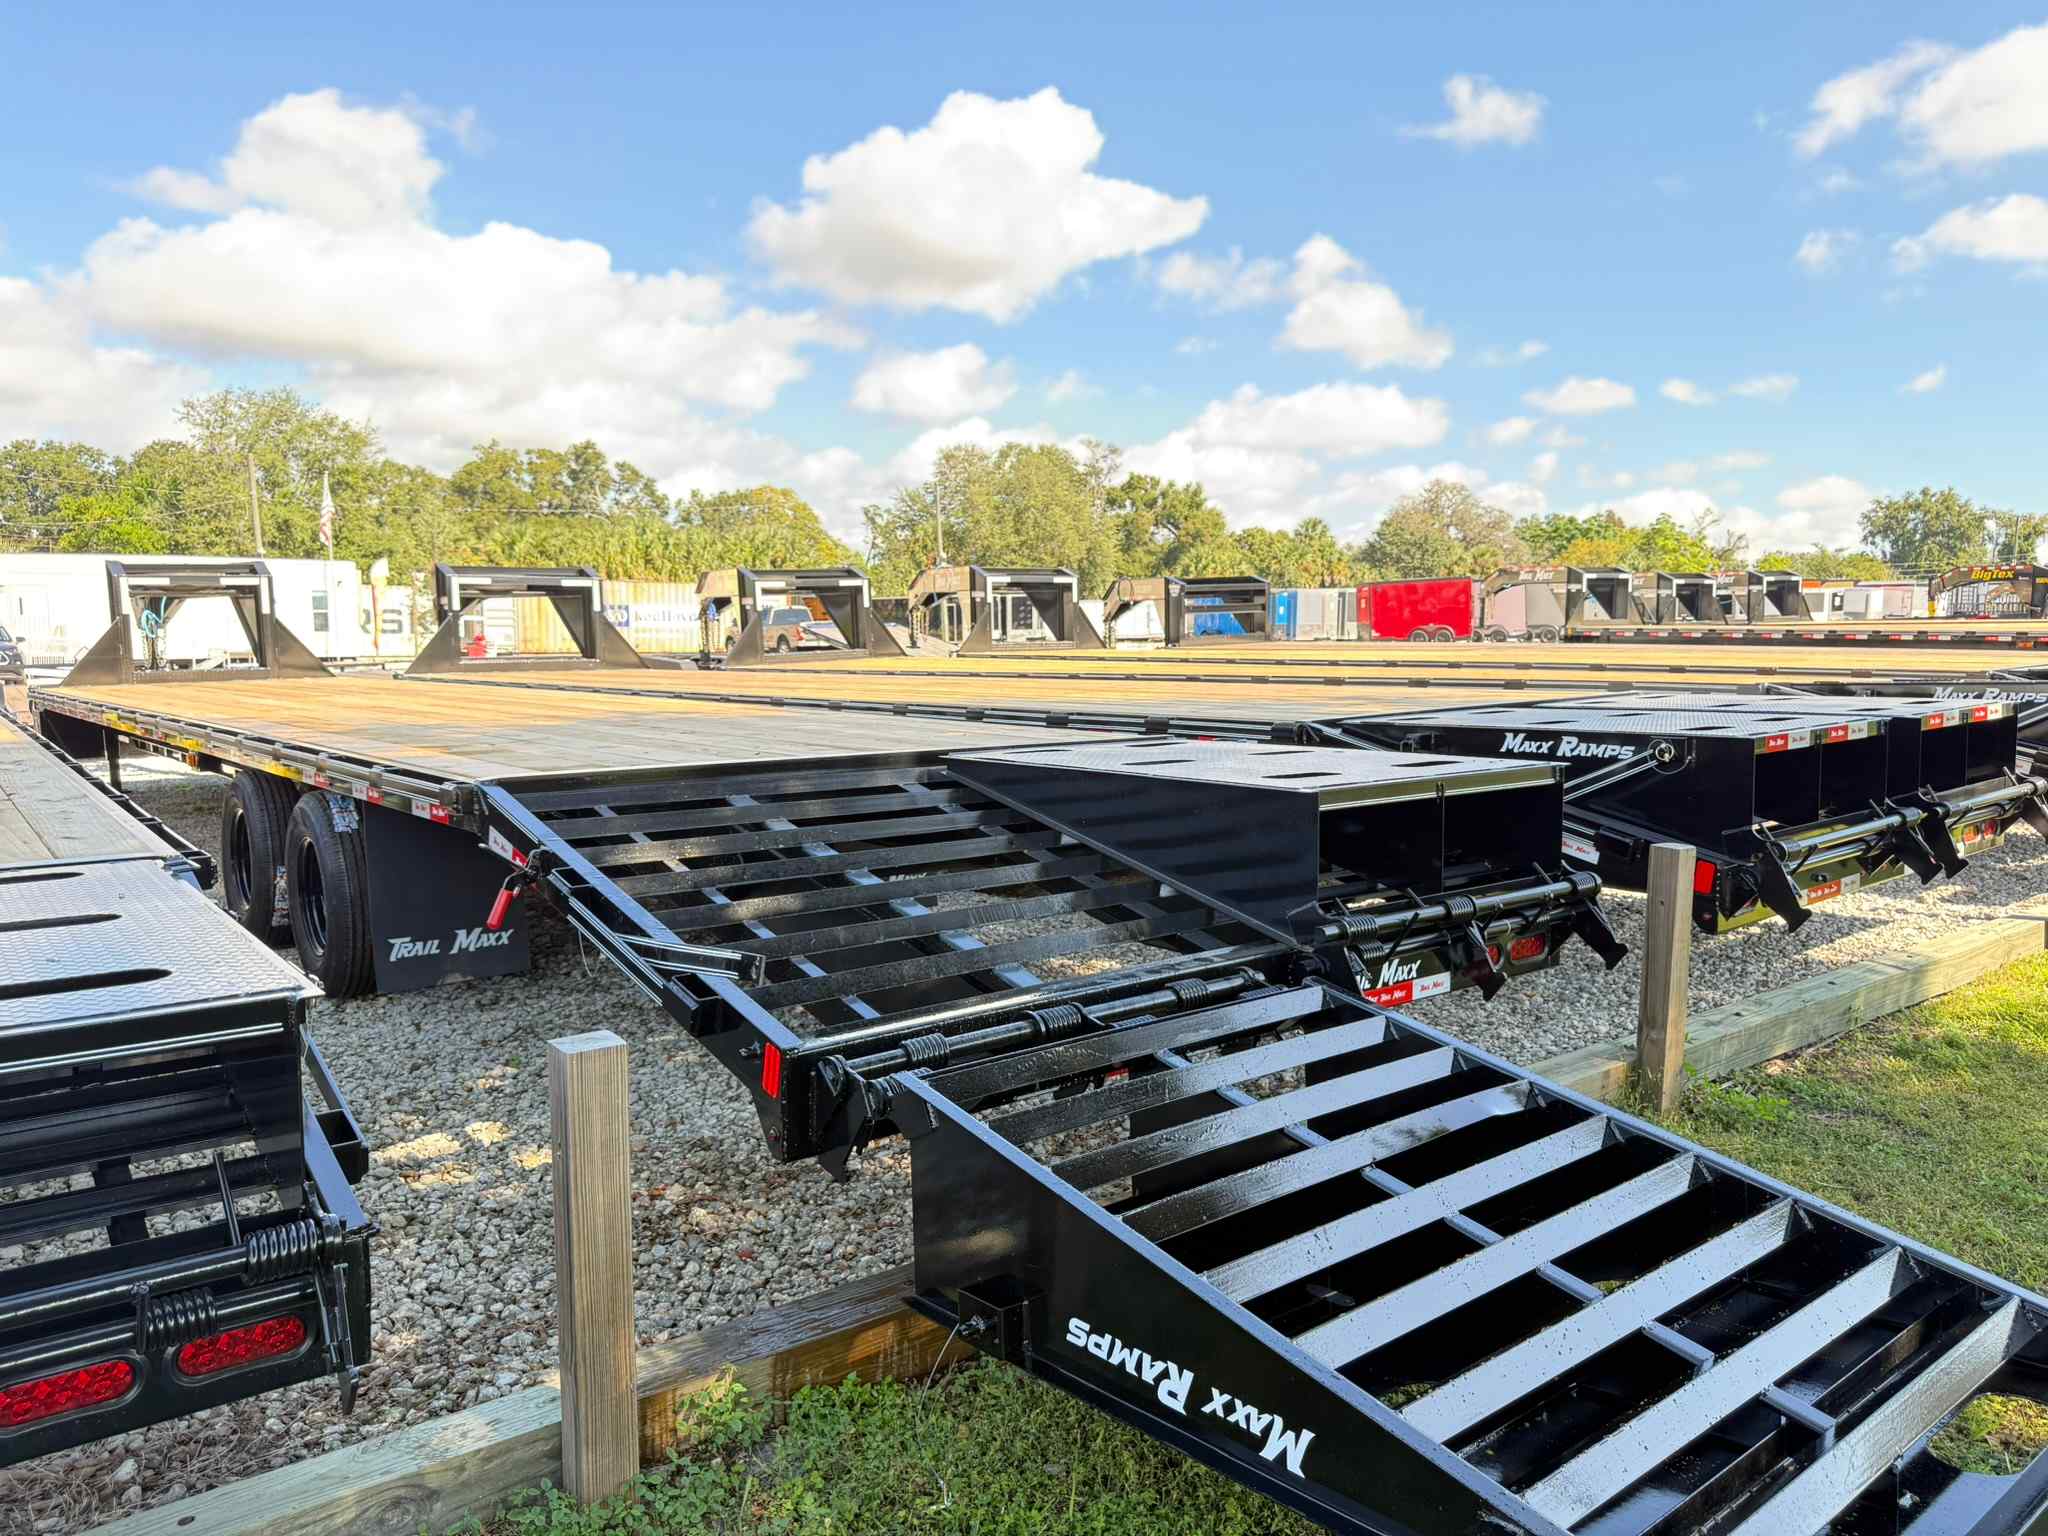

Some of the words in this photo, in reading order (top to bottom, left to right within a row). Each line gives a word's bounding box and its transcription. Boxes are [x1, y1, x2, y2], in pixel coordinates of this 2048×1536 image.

[1934, 686, 1979, 701] MAXX
[1982, 687, 2048, 703] RAMPS
[1500, 732, 1555, 754] MAXX
[1556, 735, 1635, 760] RAMPS
[386, 936, 440, 962] TRAIL
[448, 927, 514, 955] MAXX
[1376, 958, 1421, 989] MAXX
[1066, 1317, 1194, 1416] RAMPS
[1201, 1387, 1316, 1479] MAXX
